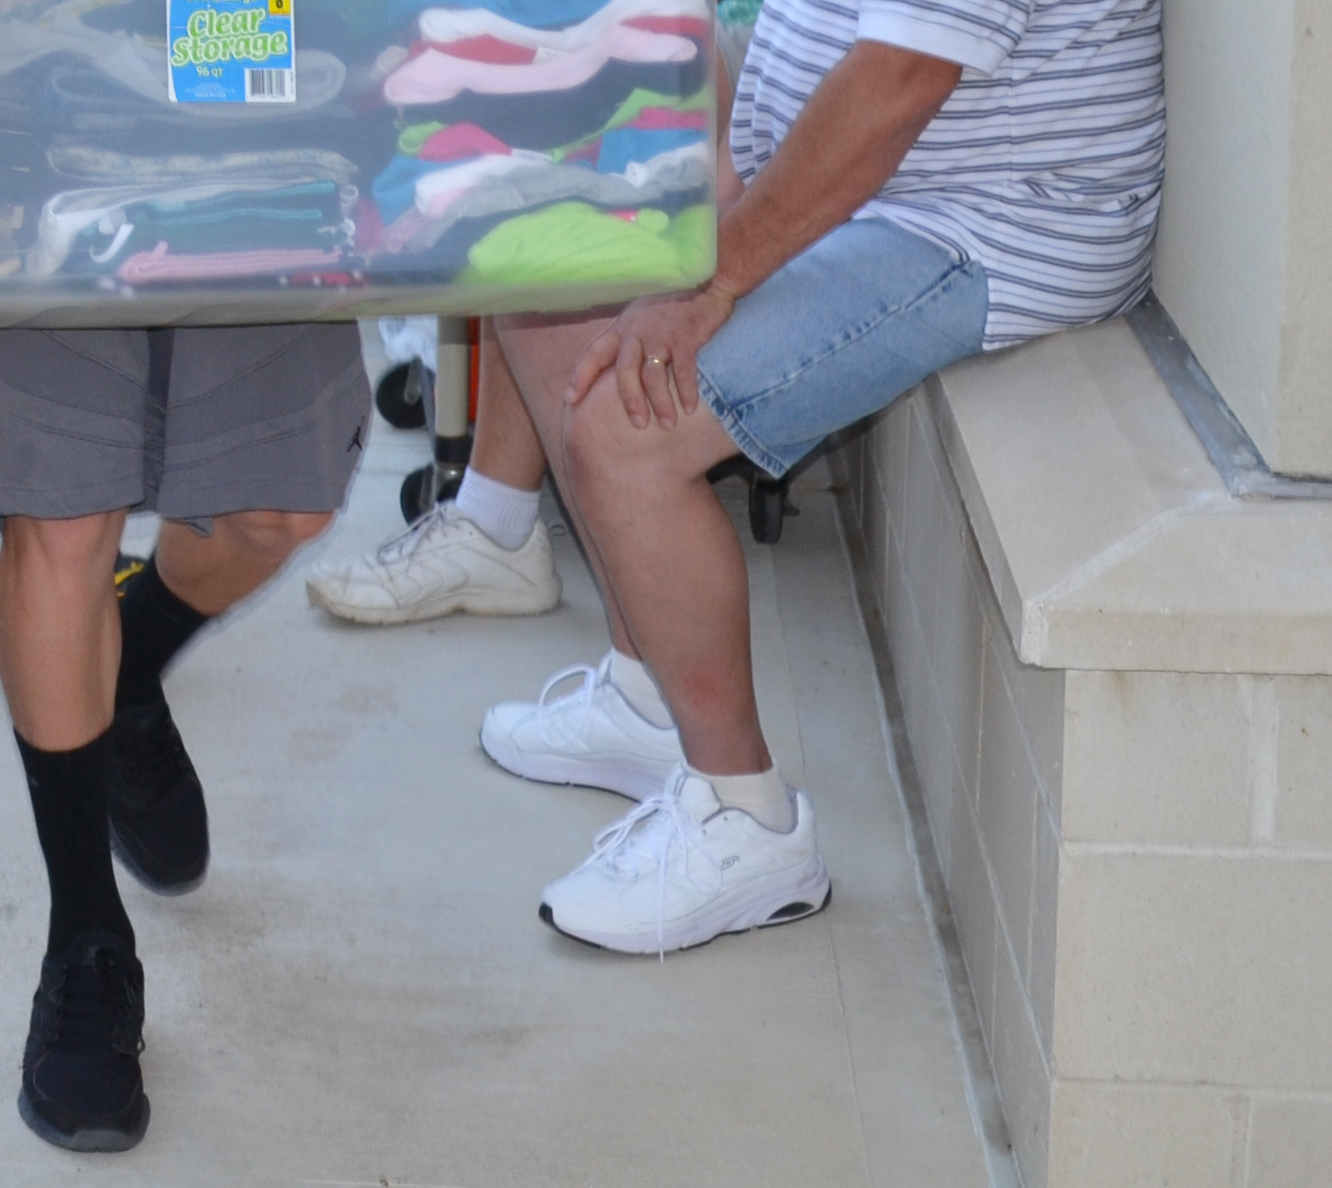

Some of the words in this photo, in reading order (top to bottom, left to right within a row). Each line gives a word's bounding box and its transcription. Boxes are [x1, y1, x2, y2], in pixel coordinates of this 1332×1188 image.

[187, 8, 266, 38] Clear
[171, 31, 288, 66] Storage
[196, 66, 210, 77] 96
[211, 68, 224, 77] QT
